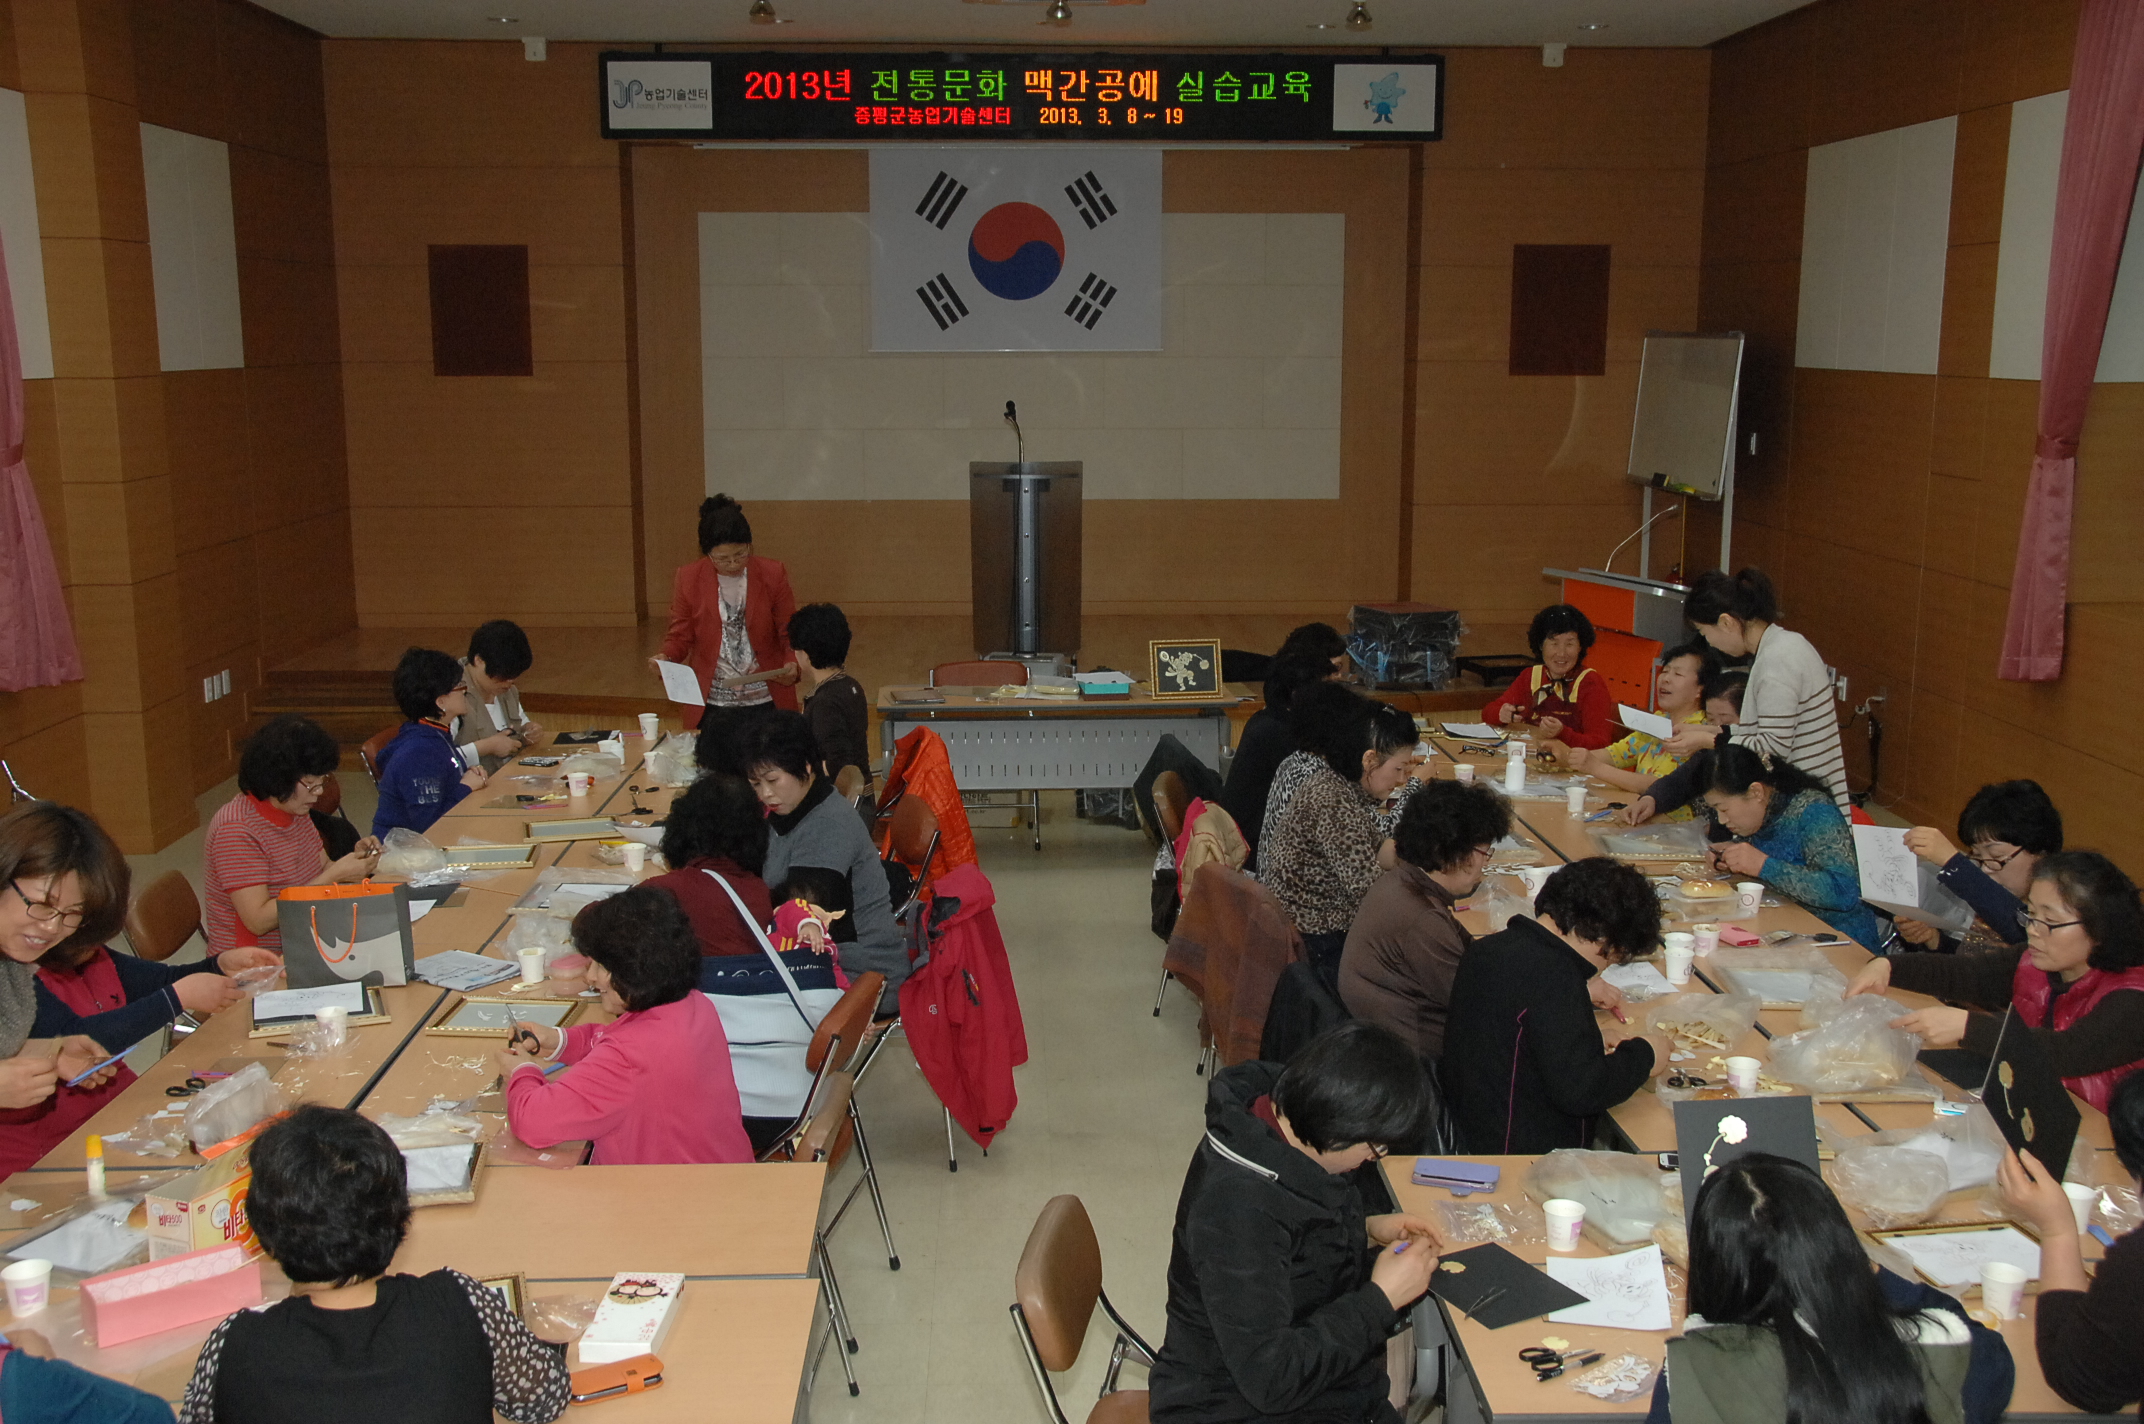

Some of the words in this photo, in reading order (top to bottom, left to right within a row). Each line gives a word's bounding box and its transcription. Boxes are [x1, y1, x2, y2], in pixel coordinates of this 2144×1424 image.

[644, 88, 708, 101] 농업기술센터
[744, 69, 851, 101] 2013년
[870, 69, 1008, 102] 전통문화
[1024, 69, 1159, 102] 맥간공예
[1176, 70, 1312, 102] 실습교육
[853, 106, 1011, 125] 증평군농업기술센터
[1039, 107, 1083, 125] 2013.
[223, 1208, 249, 1241] 비타
